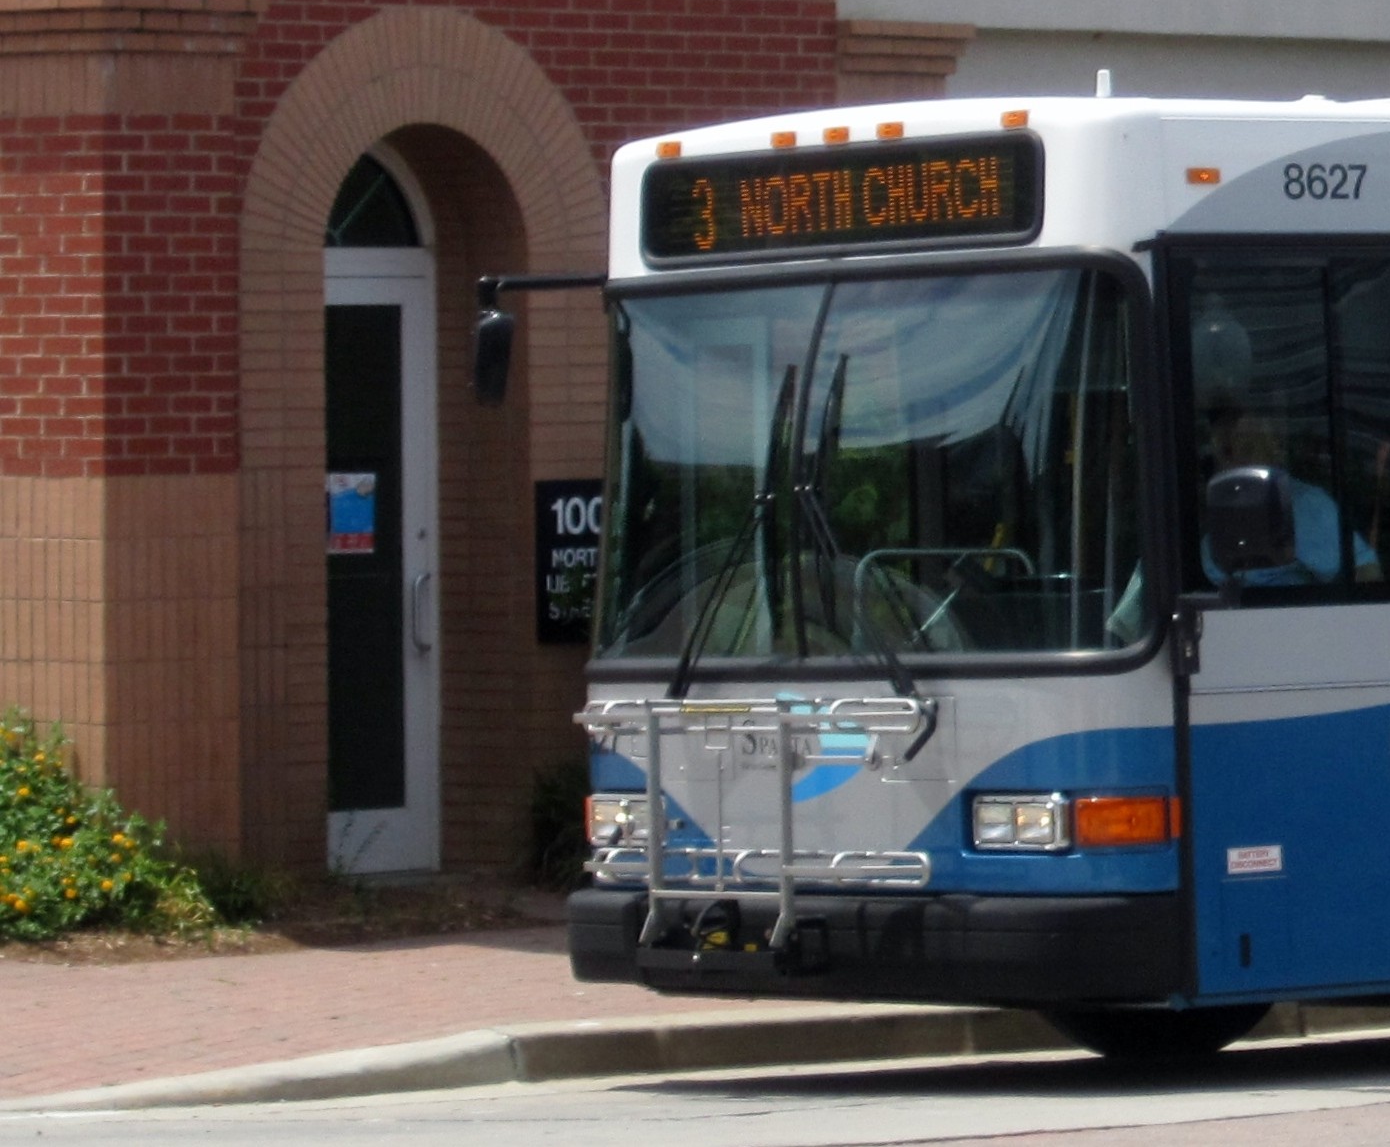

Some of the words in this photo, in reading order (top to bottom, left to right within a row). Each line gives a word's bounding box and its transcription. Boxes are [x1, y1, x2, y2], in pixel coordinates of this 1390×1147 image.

[1283, 162, 1368, 200] 8627
[692, 179, 716, 250] 3
[739, 170, 852, 237] NORTH
[863, 157, 999, 226] CHURCH
[552, 548, 598, 568] NORT
[742, 719, 812, 755] SPATA
